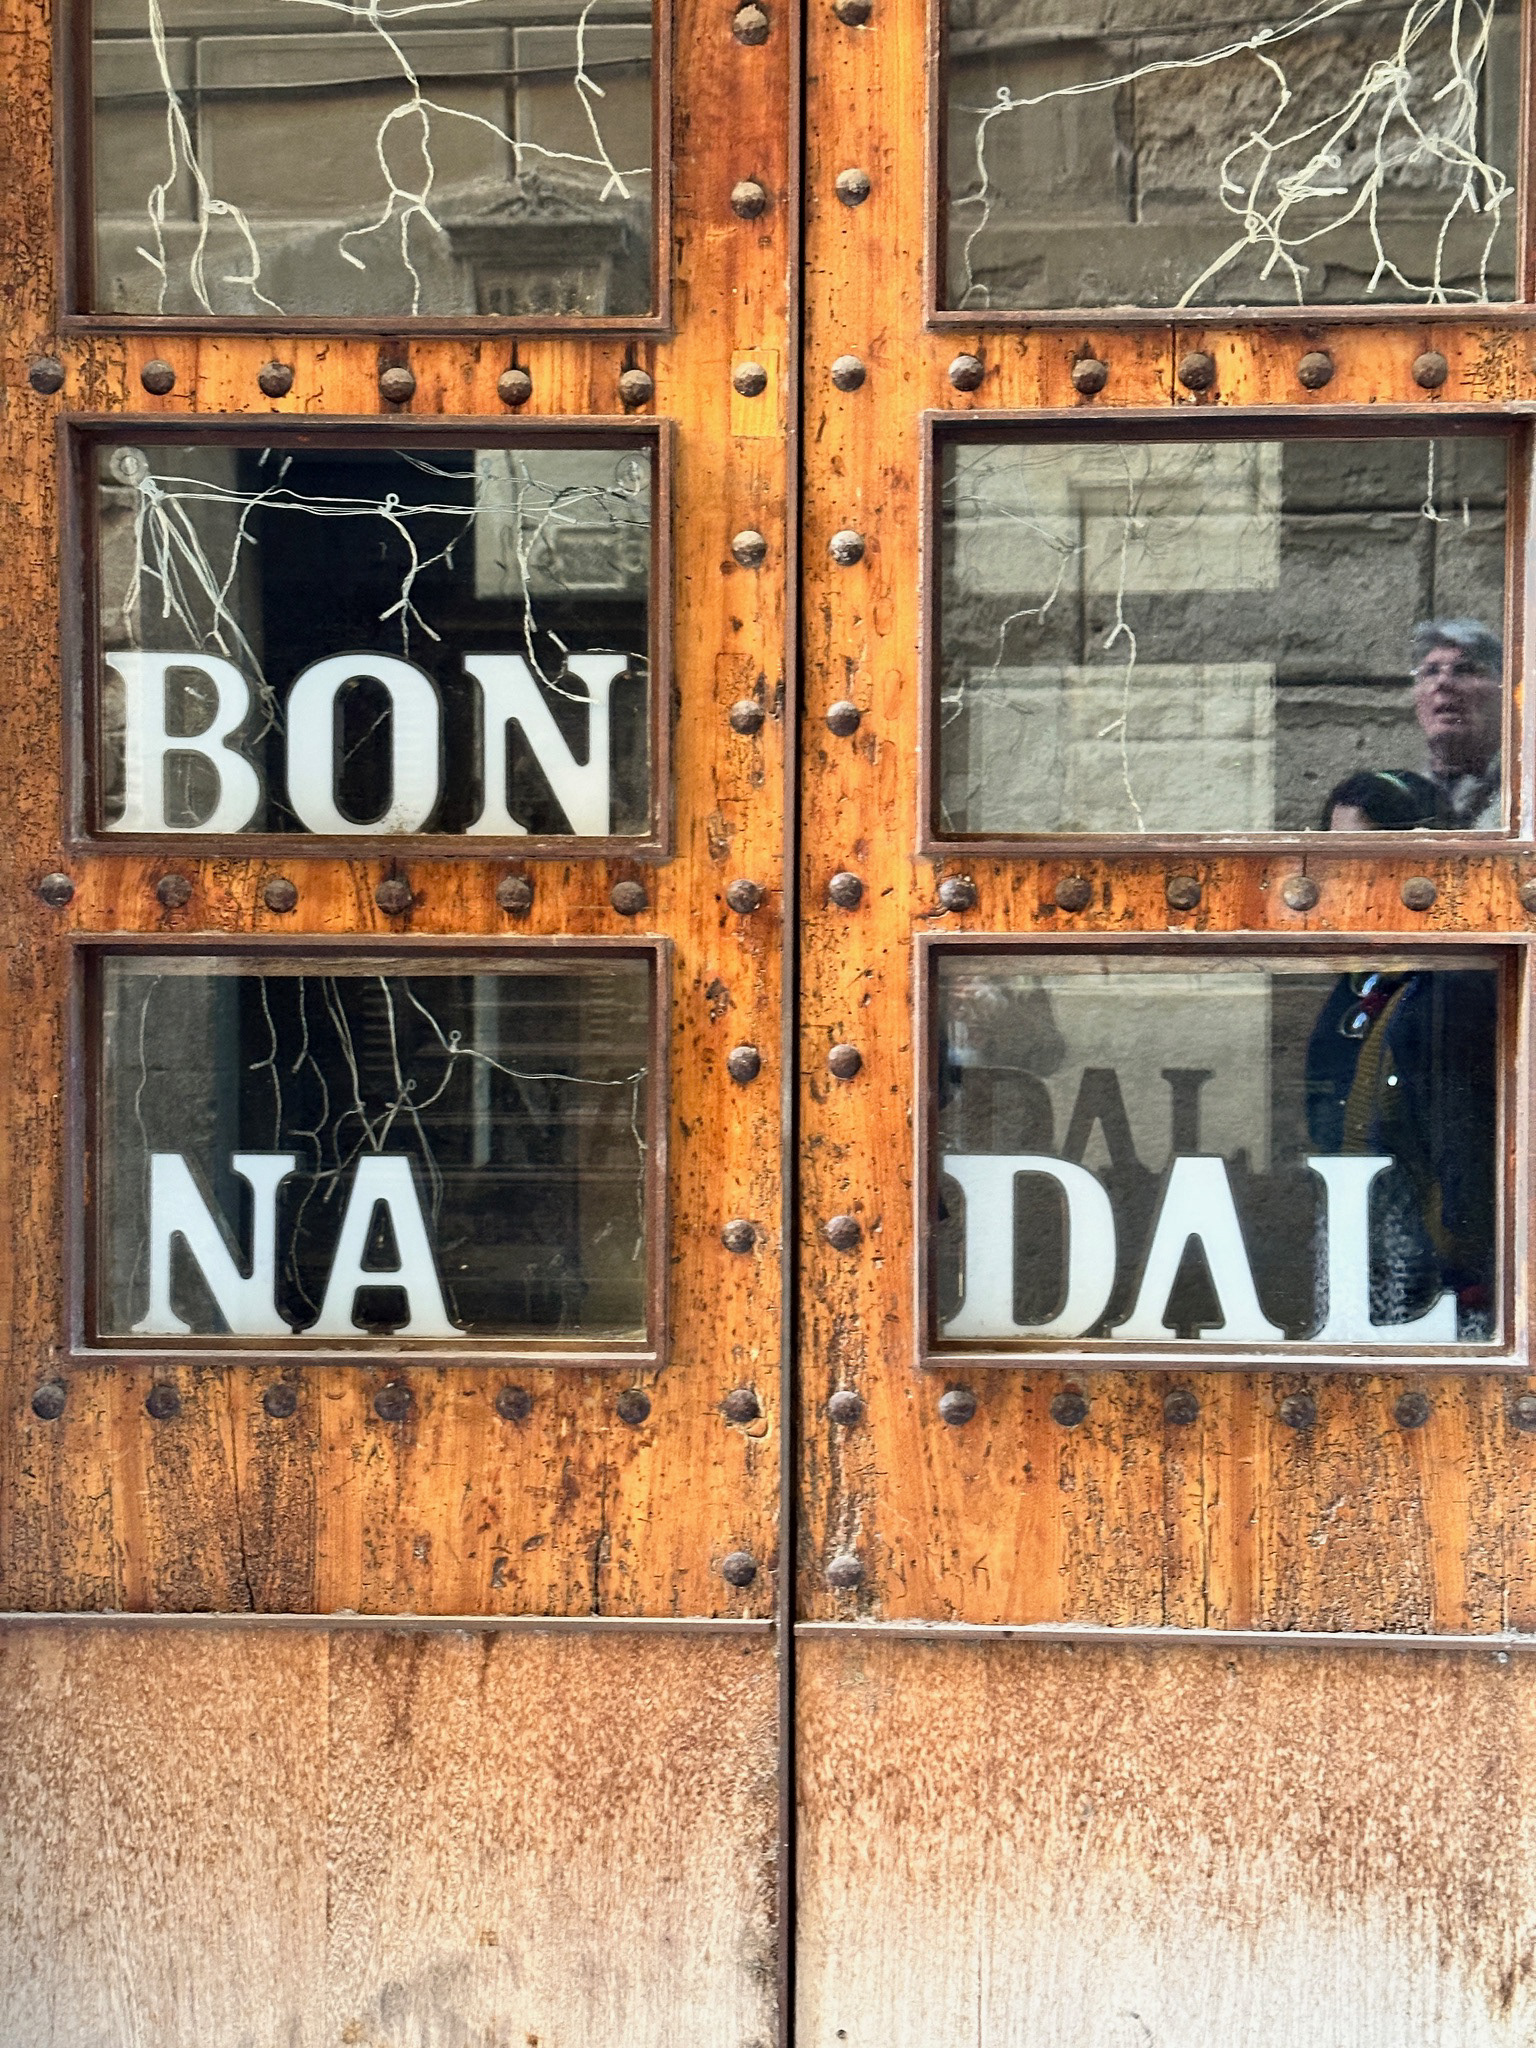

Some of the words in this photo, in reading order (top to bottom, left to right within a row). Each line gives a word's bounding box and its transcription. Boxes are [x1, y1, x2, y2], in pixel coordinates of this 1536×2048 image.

[105, 652, 627, 836] BON
[131, 1153, 466, 1335] NA
[943, 1156, 1457, 1342] DAL
